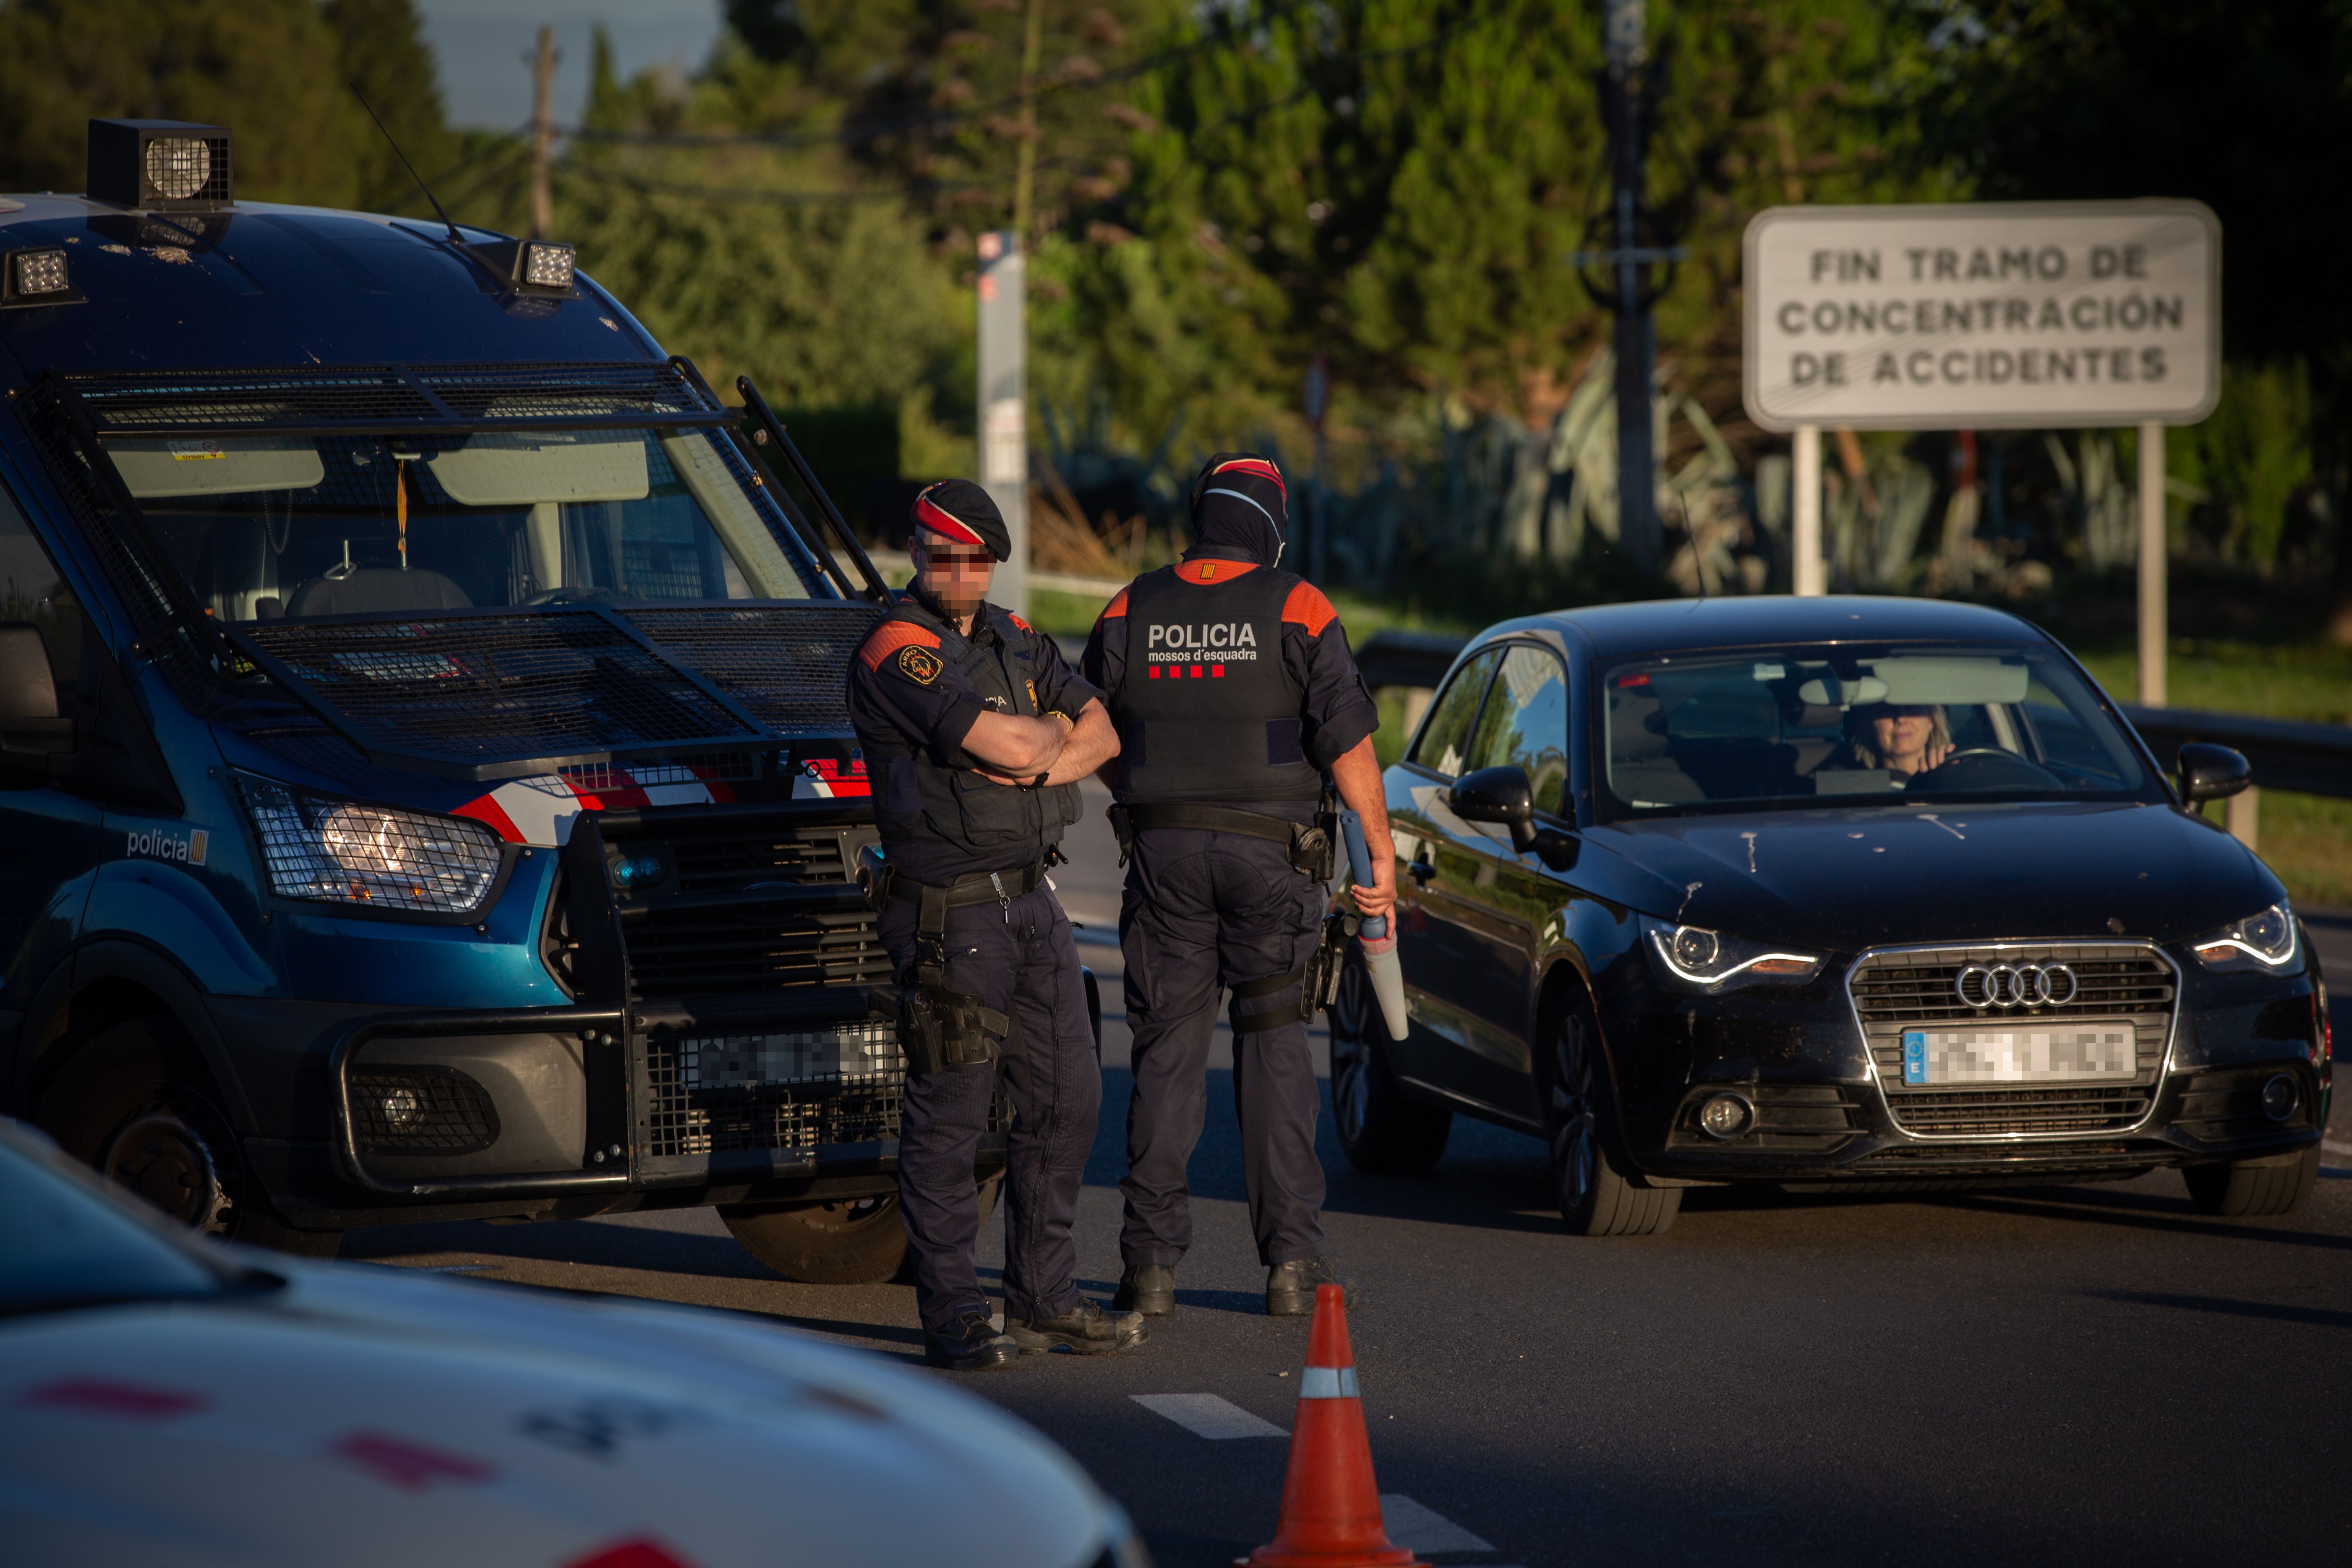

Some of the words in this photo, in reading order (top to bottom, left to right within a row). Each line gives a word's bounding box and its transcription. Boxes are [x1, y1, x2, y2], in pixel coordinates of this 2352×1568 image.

[1810, 250, 1881, 283] FIN
[1904, 245, 2068, 282] TRAMO
[2091, 243, 2148, 281] DE
[1777, 287, 2182, 335] CONCENTRACIÓN
[1791, 351, 1849, 386] DE
[1874, 346, 2169, 386] ACCIDENTES
[1149, 623, 1257, 648] POLICIA
[903, 650, 917, 667] ARRO
[1149, 652, 1191, 662] mossos
[127, 829, 188, 861] policia
[1911, 1062, 1920, 1073] E
